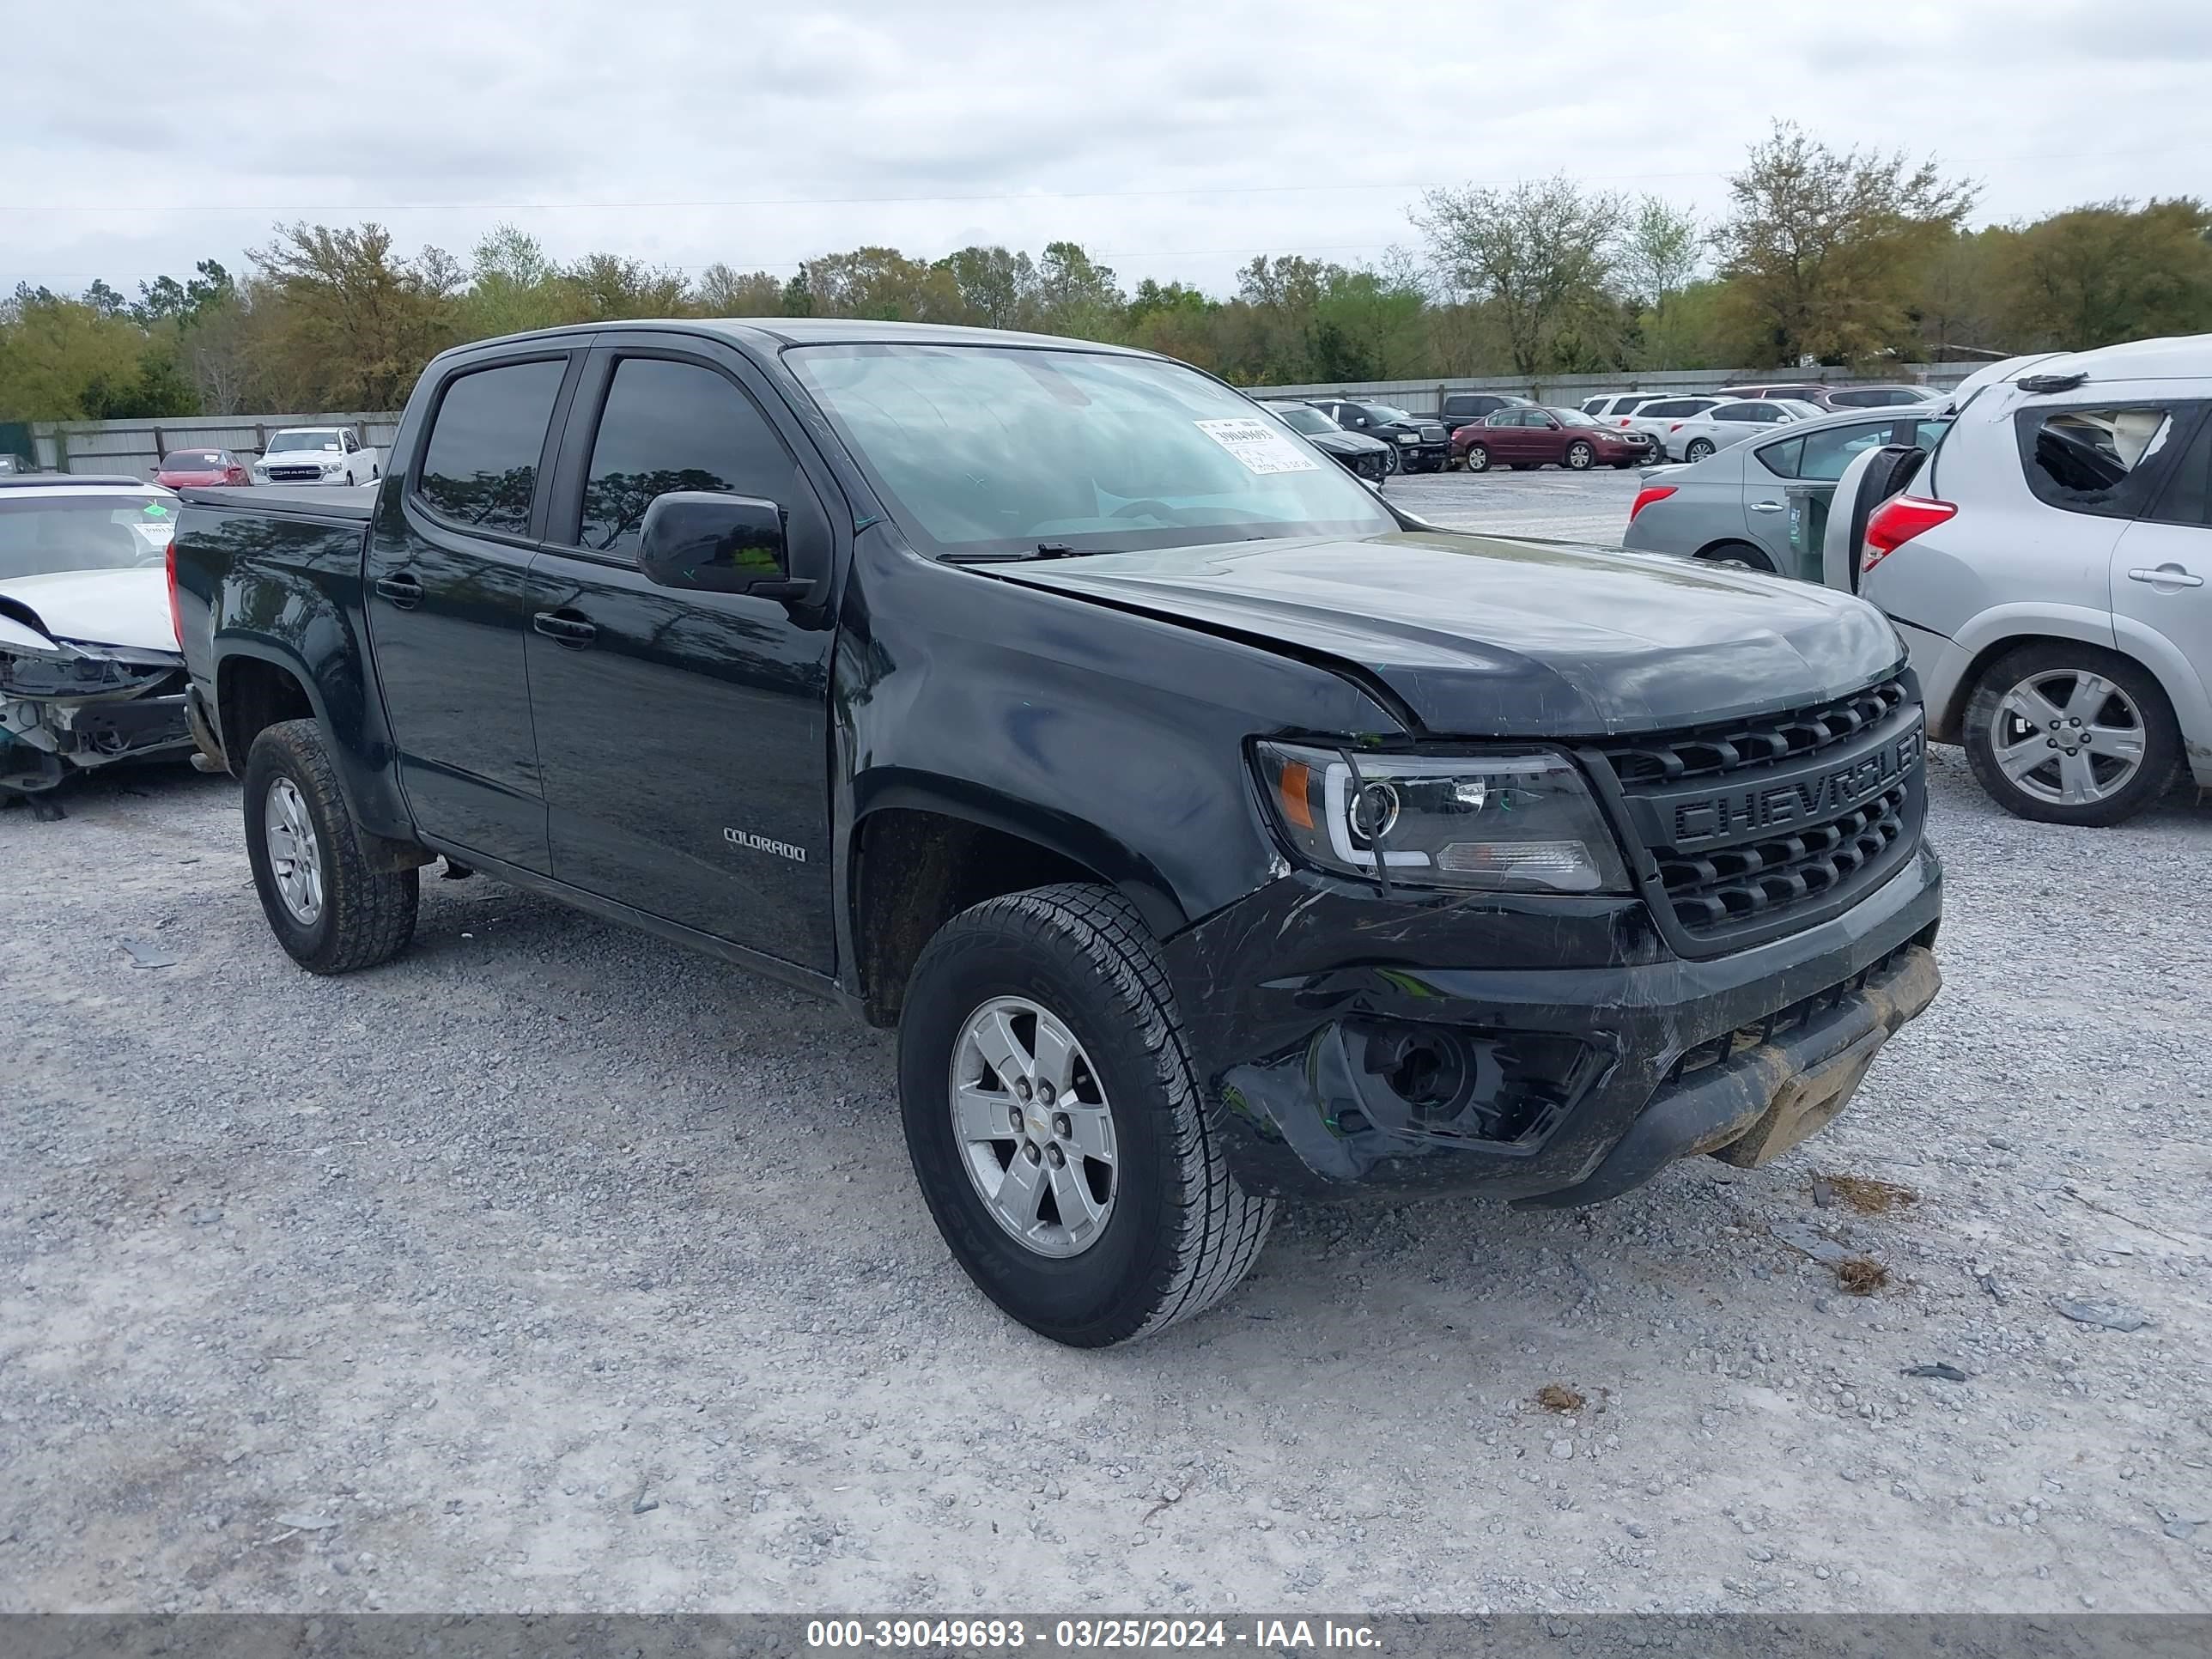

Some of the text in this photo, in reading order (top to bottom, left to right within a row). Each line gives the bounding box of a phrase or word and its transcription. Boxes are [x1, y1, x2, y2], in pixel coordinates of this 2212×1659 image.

[1215, 429, 1274, 442] 39049693
[1675, 728, 1923, 843] CHEVROLET
[723, 827, 806, 862] COLORADO
